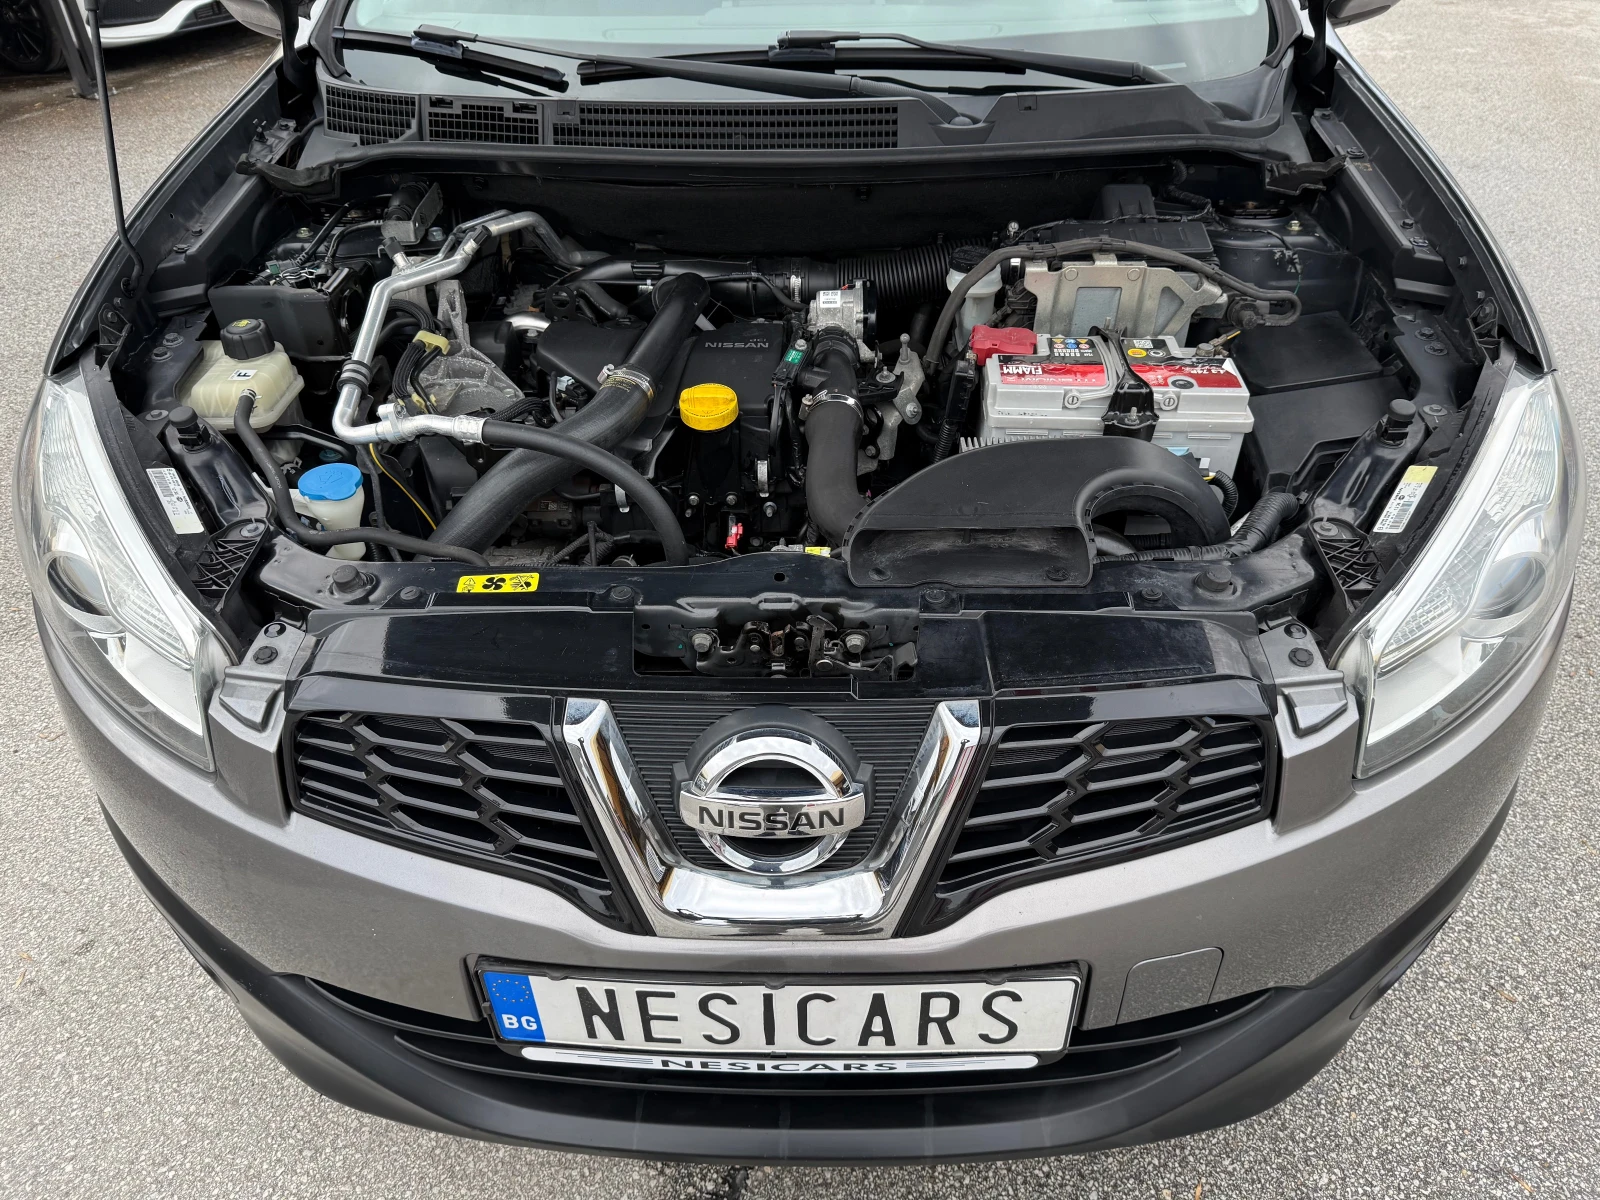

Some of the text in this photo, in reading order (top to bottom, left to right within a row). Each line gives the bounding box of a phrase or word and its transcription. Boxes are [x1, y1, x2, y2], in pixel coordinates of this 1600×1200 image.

[1002, 365, 1043, 375] FIAMM
[698, 805, 845, 832] NISSAN
[501, 984, 1024, 1047] BG NESICARS
[661, 1059, 898, 1073] NESICARS
